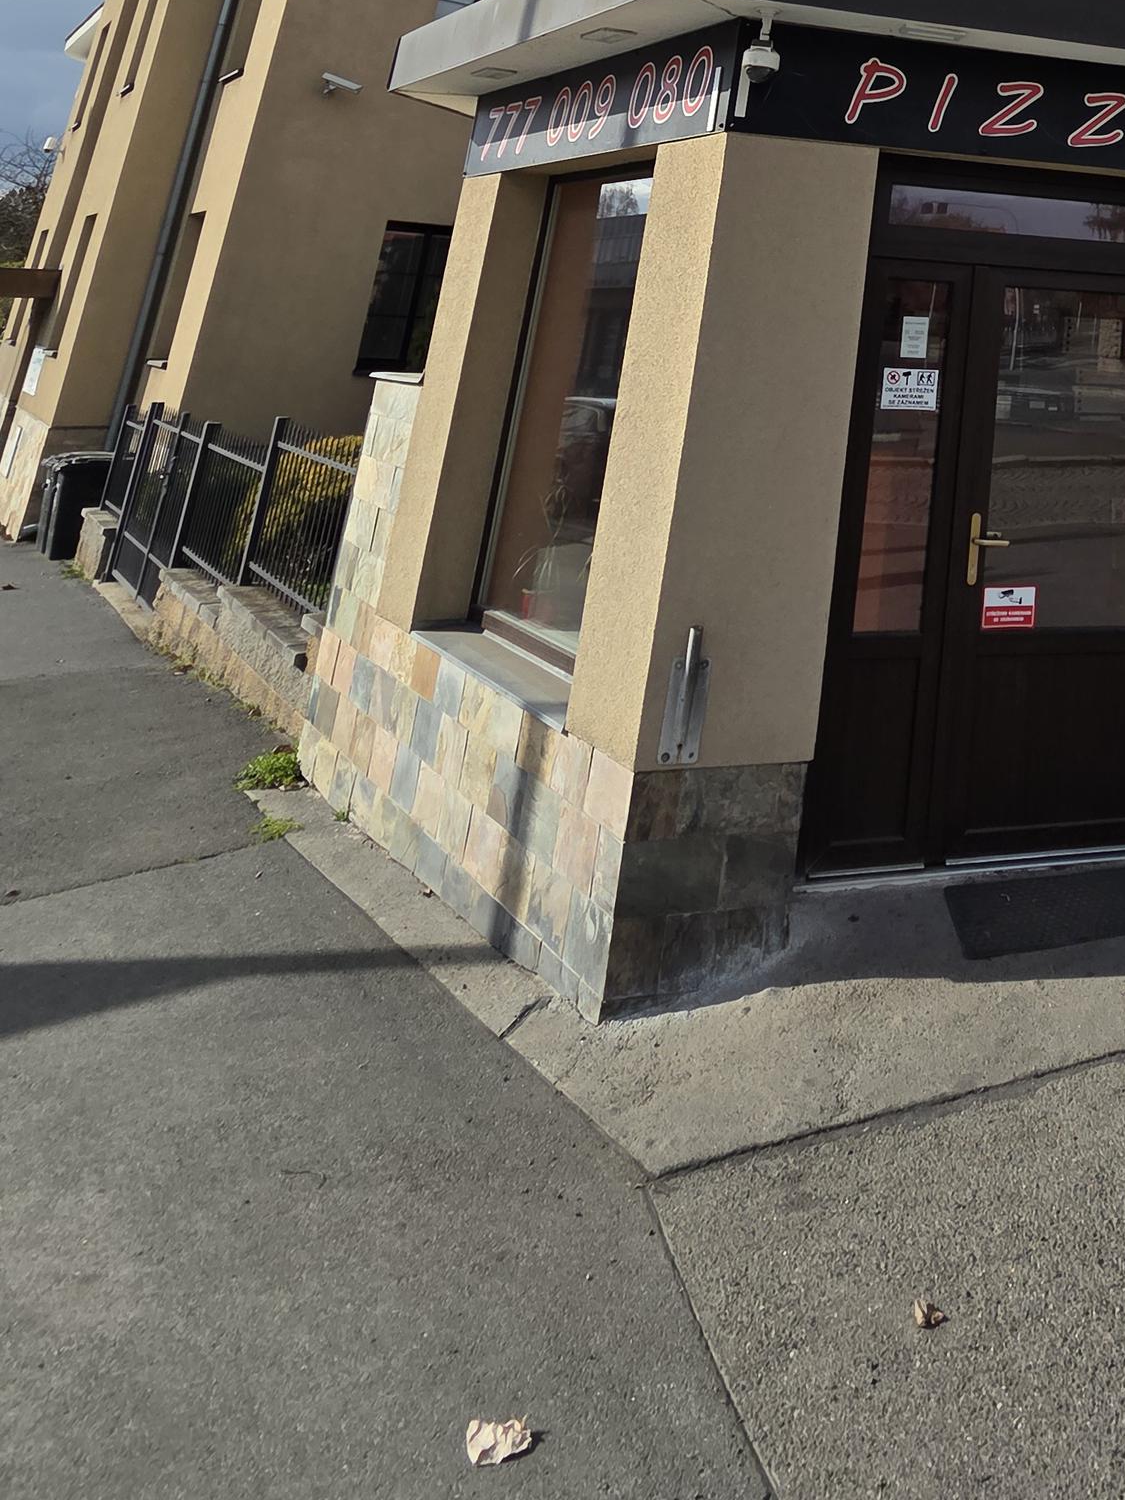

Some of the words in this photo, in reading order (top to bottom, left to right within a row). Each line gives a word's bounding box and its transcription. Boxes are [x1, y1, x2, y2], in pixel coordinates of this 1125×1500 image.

[480, 95, 542, 162] 777
[546, 73, 616, 147] 009
[628, 45, 715, 130] 080
